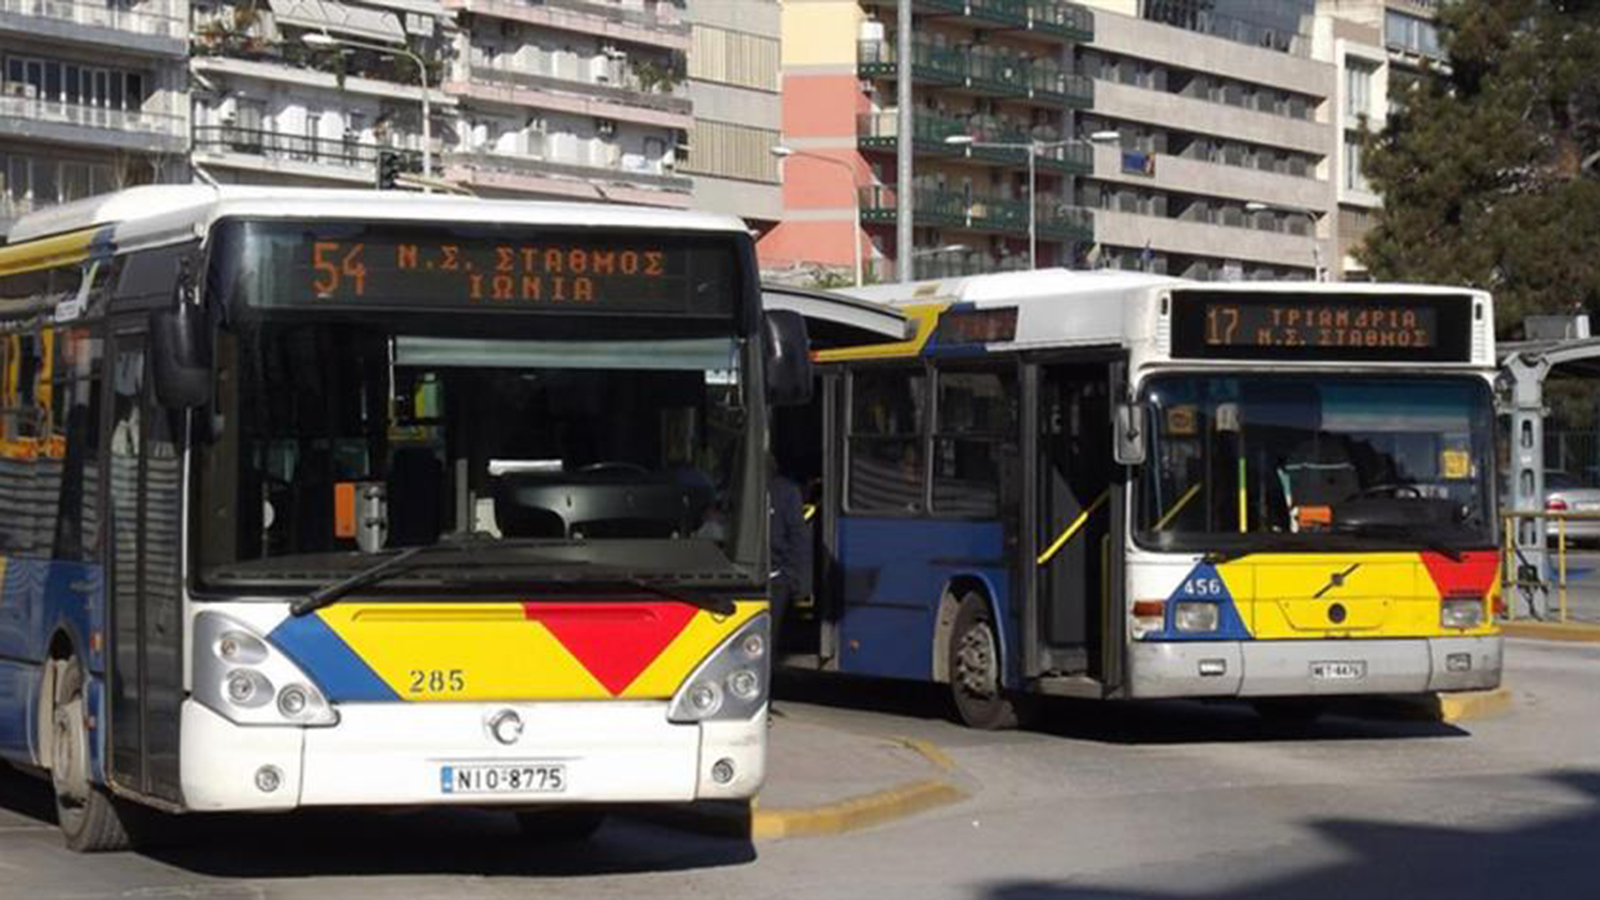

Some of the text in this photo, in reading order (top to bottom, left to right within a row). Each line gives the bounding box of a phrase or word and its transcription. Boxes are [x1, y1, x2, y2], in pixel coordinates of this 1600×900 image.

[313, 242, 366, 296] 54
[496, 246, 664, 275] ΣΤΑΘΜΟΣ
[1206, 309, 1239, 345] 17
[1319, 330, 1429, 348] ΣΤΑΘΜΟΣ
[1184, 579, 1220, 595] 456
[409, 669, 464, 692] 285
